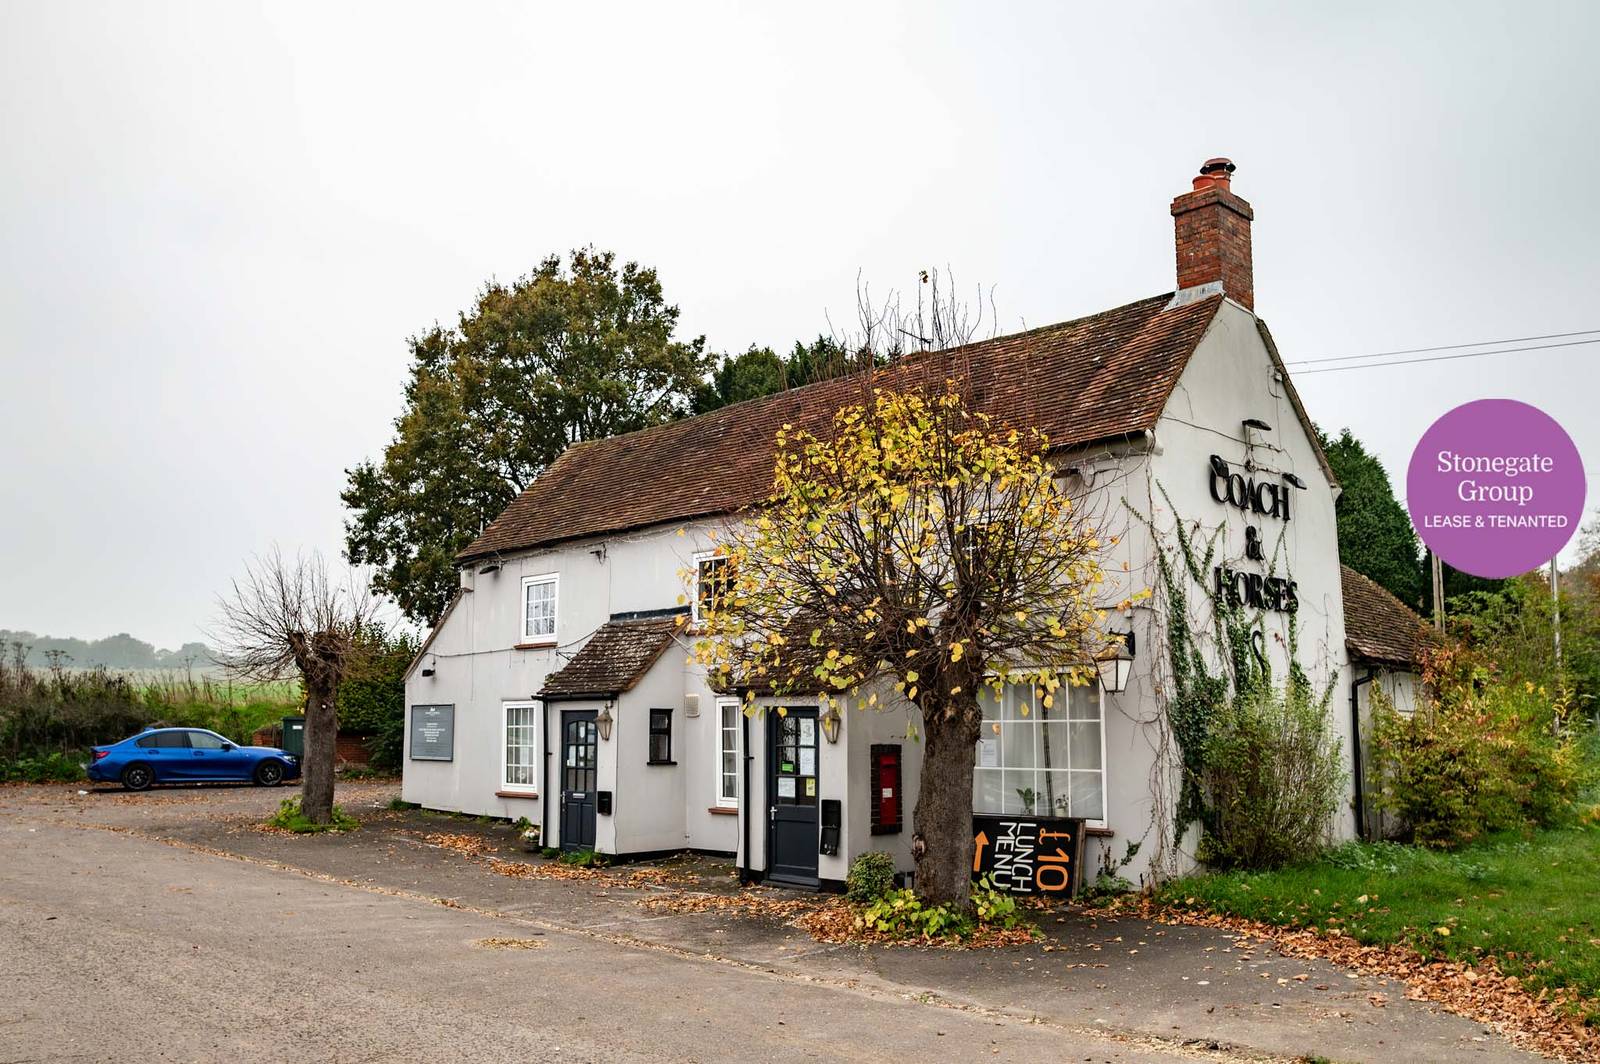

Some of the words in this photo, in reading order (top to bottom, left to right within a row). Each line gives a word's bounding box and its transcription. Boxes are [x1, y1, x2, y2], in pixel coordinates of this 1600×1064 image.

[1209, 460, 1290, 521] COACH
[1245, 525, 1264, 560] &
[1214, 567, 1299, 614] HORSES
[992, 821, 1017, 888] MENU
[1010, 822, 1037, 892] LUNCH
[1036, 827, 1071, 891] £10
